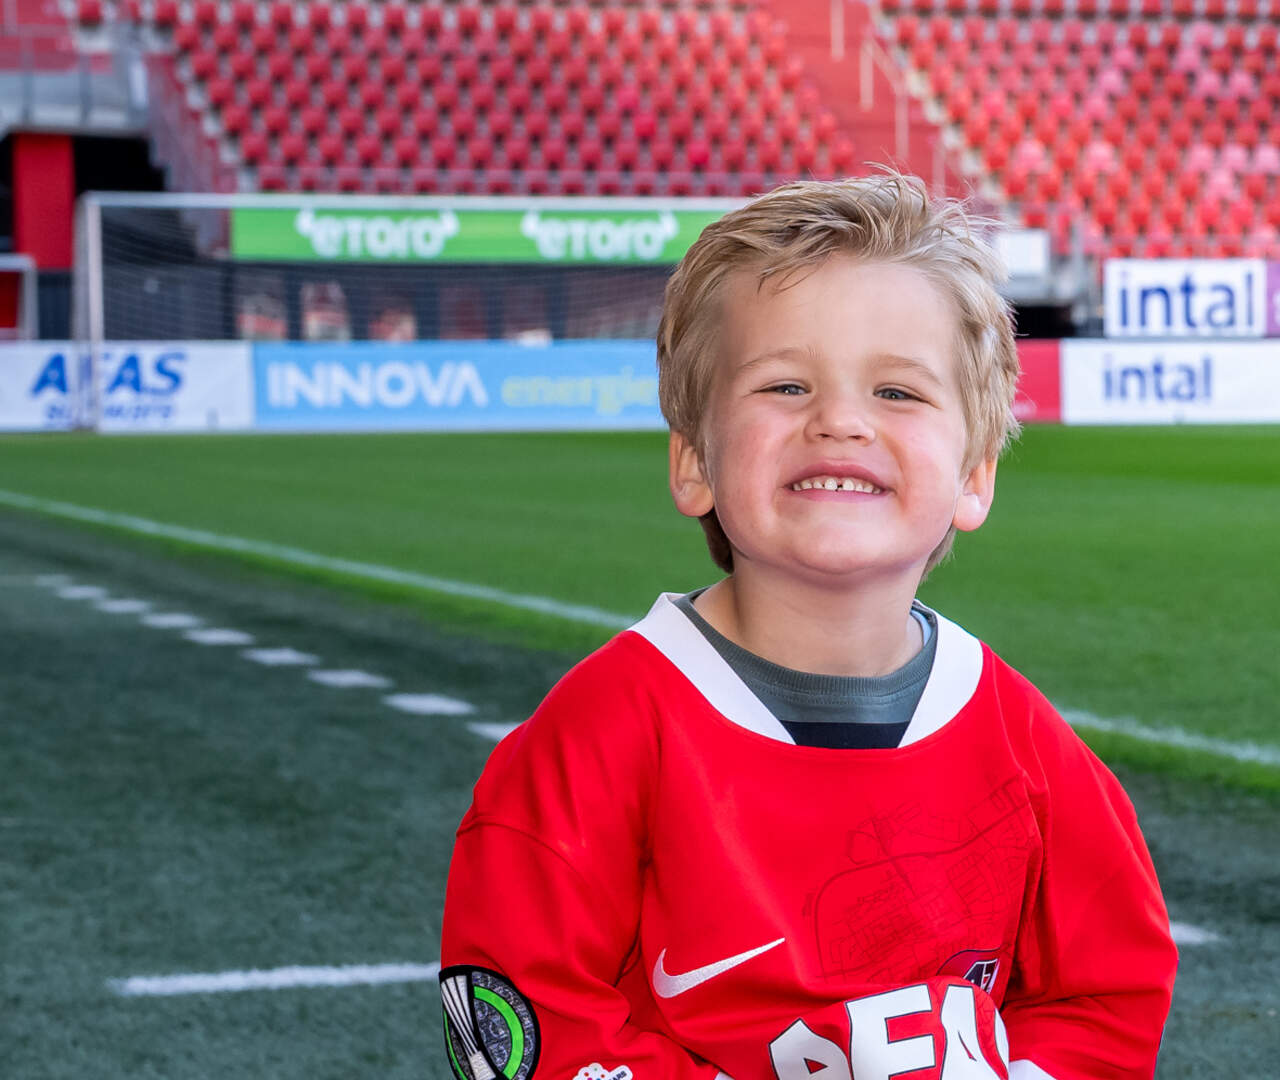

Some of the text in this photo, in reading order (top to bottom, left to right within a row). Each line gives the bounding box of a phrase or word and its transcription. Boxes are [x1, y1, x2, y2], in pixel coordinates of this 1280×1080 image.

[1118, 270, 1254, 329] intal
[266, 362, 490, 407] INNOVA
[1104, 354, 1213, 402] intal
